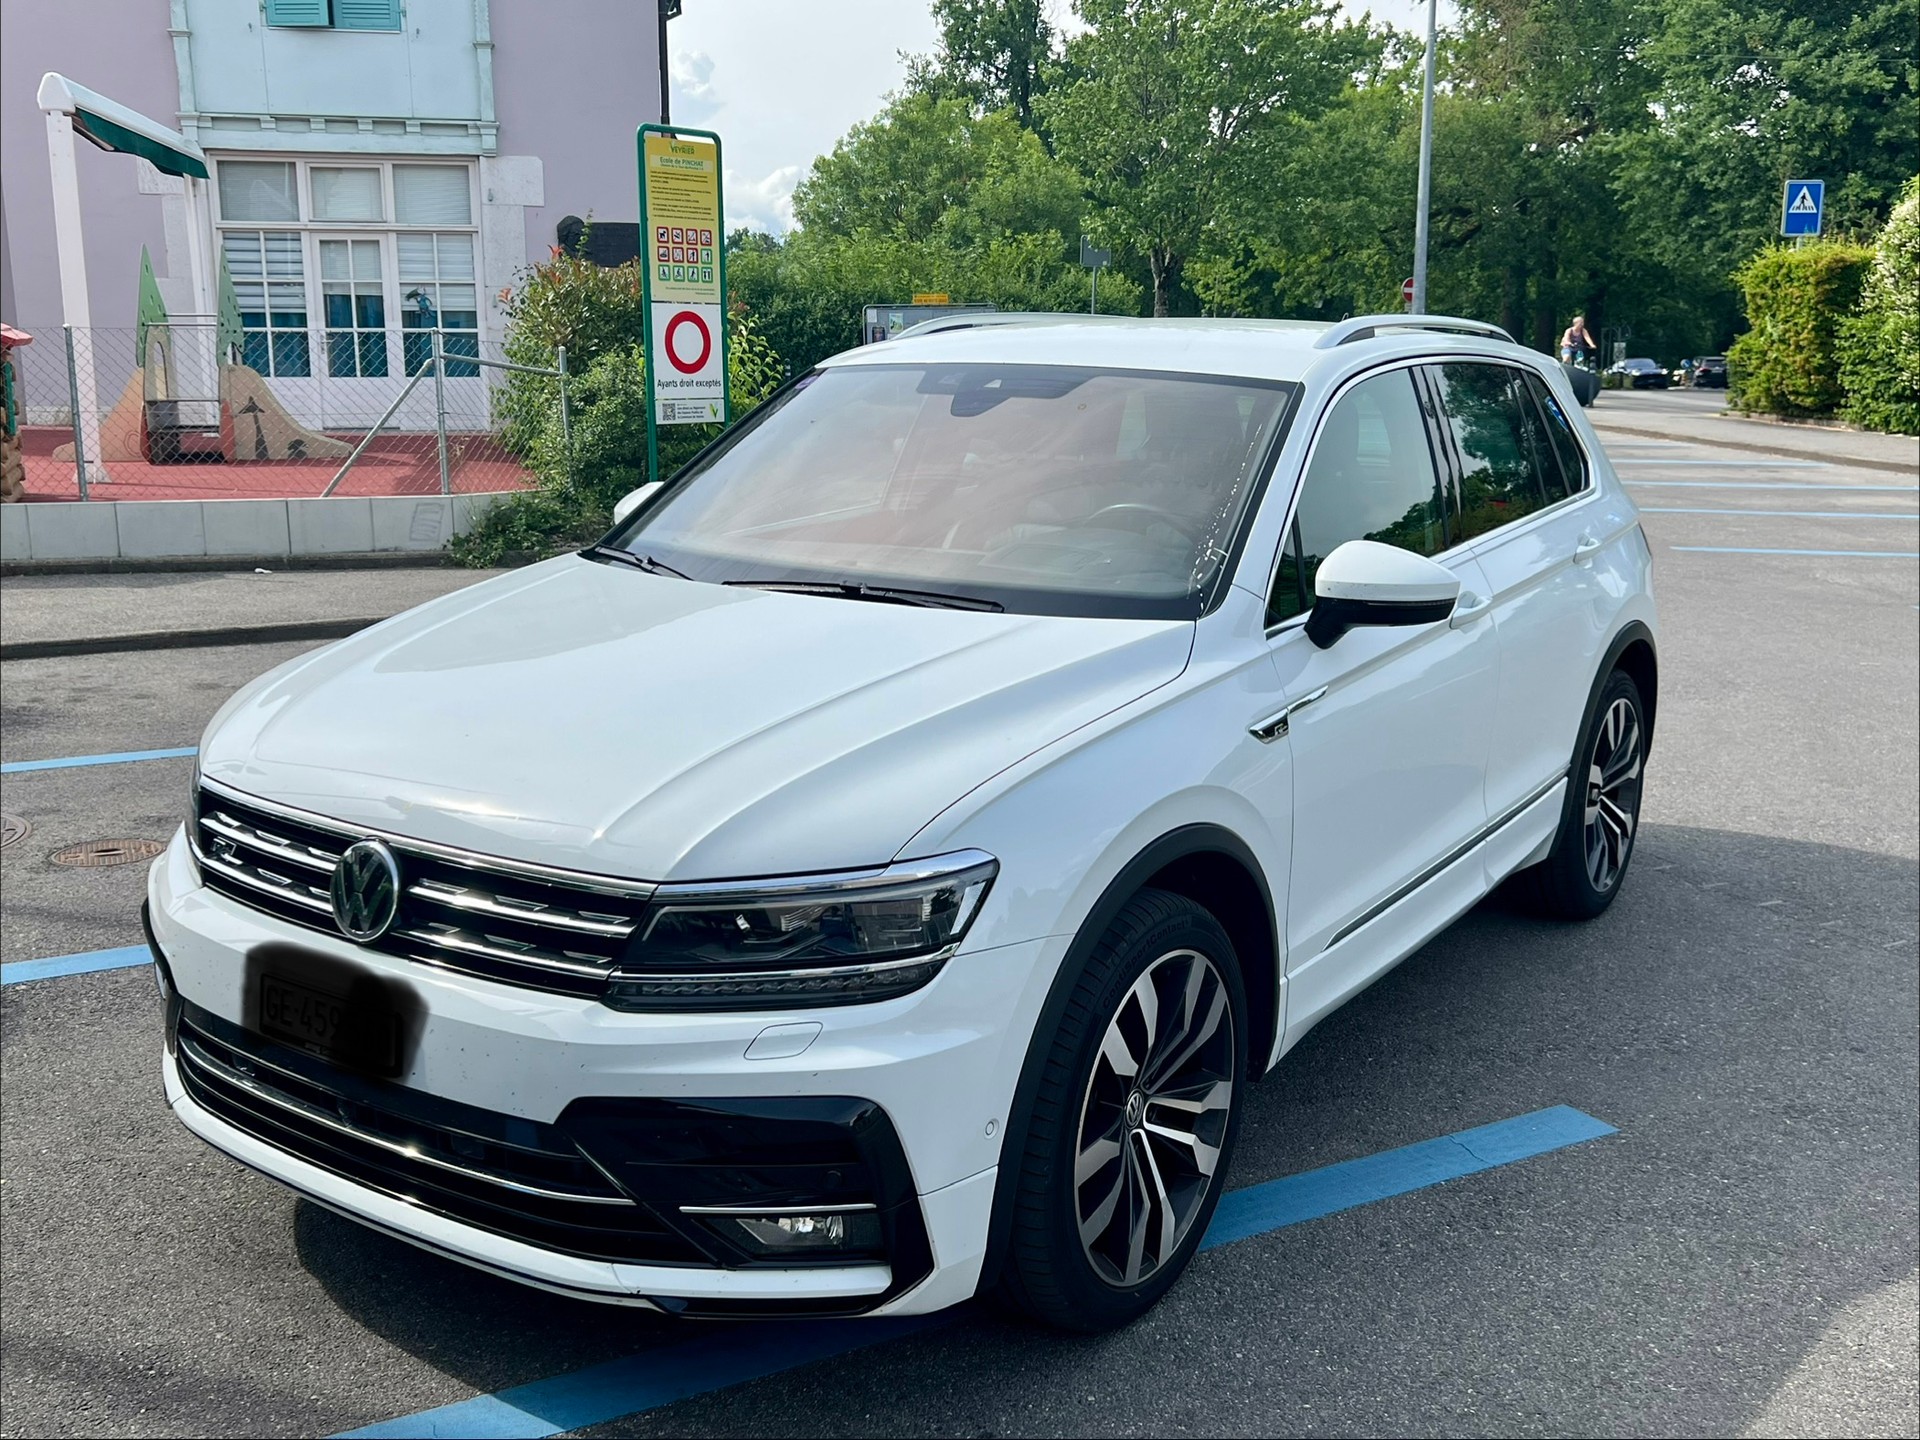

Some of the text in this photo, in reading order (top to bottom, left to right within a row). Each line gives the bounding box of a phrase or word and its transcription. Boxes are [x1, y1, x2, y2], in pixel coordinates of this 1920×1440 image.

[659, 156, 673, 164] Ecole
[657, 378, 722, 389] Ayants droit exceptés
